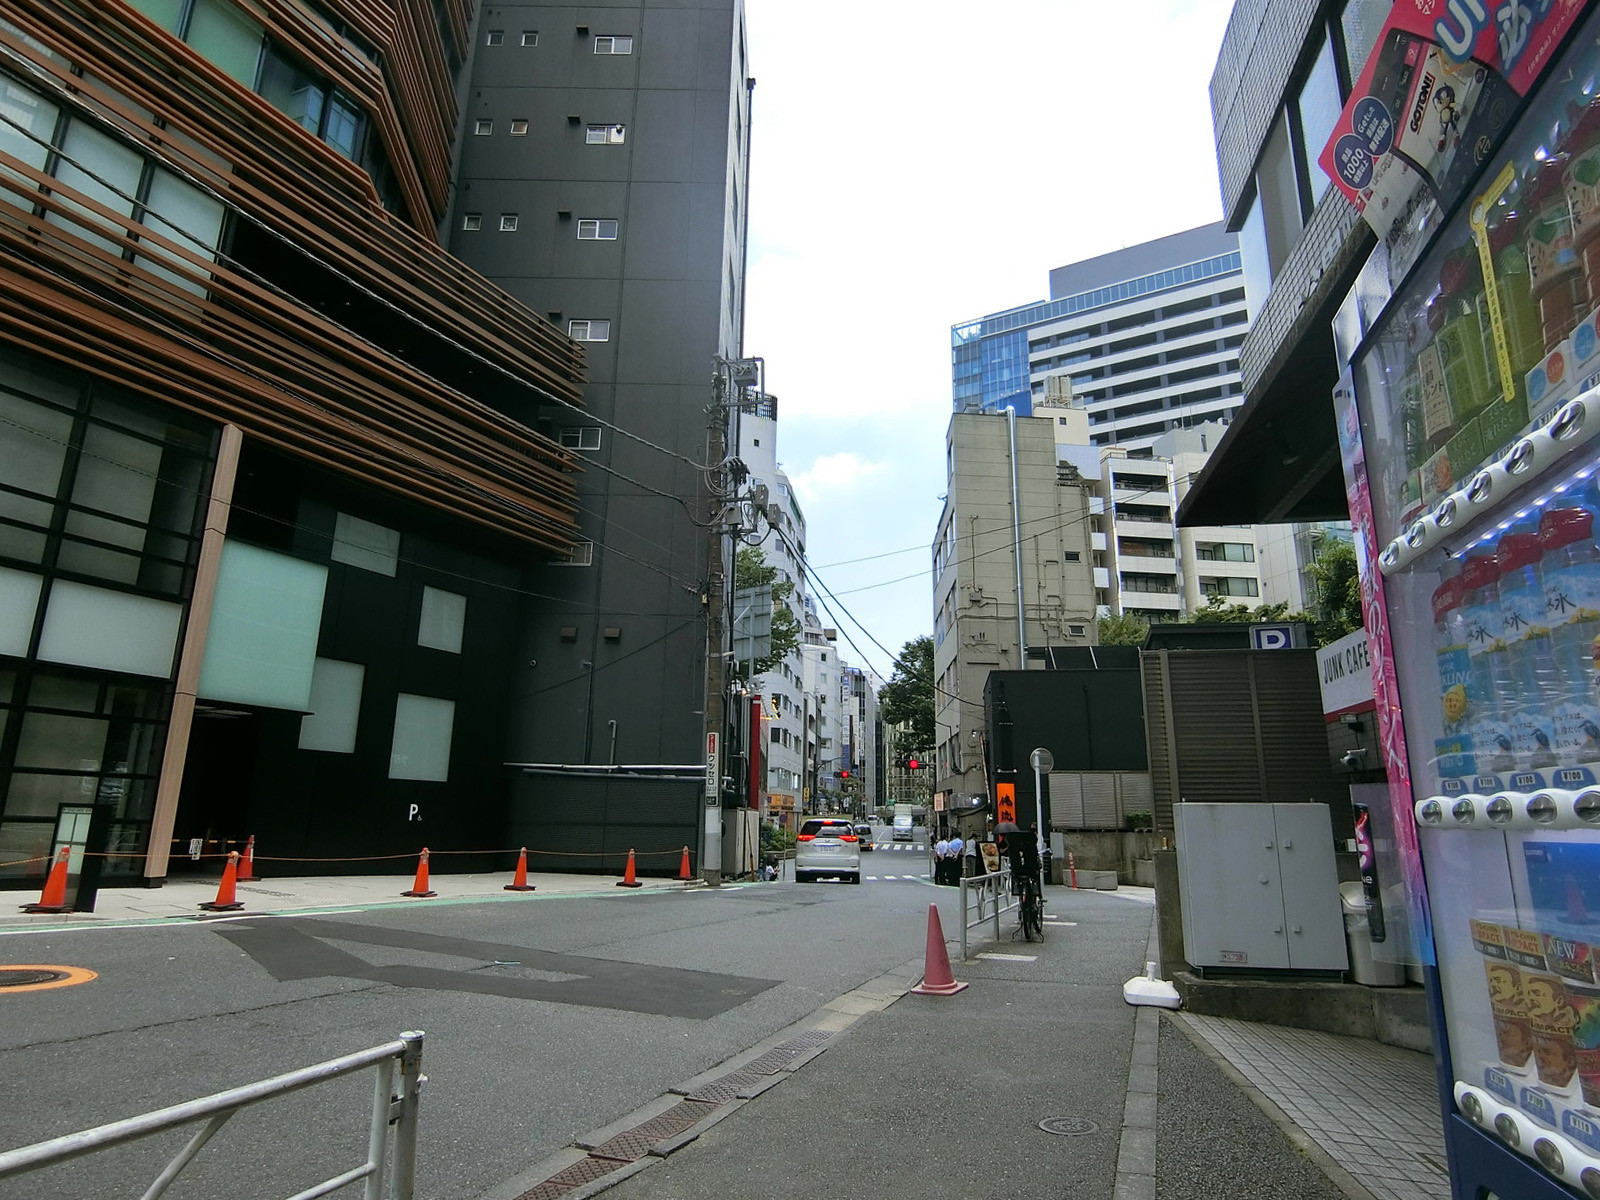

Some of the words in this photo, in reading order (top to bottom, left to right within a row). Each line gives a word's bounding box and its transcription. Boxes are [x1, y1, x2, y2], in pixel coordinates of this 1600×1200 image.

[1343, 148, 1364, 178] 1000
[1323, 650, 1345, 684] JUNK
[1346, 640, 1371, 675] CAFE
[1518, 776, 1533, 784] ¥100
[1563, 772, 1581, 781] ¥100
[409, 804, 418, 821] P
[1548, 938, 1576, 960] NEW
